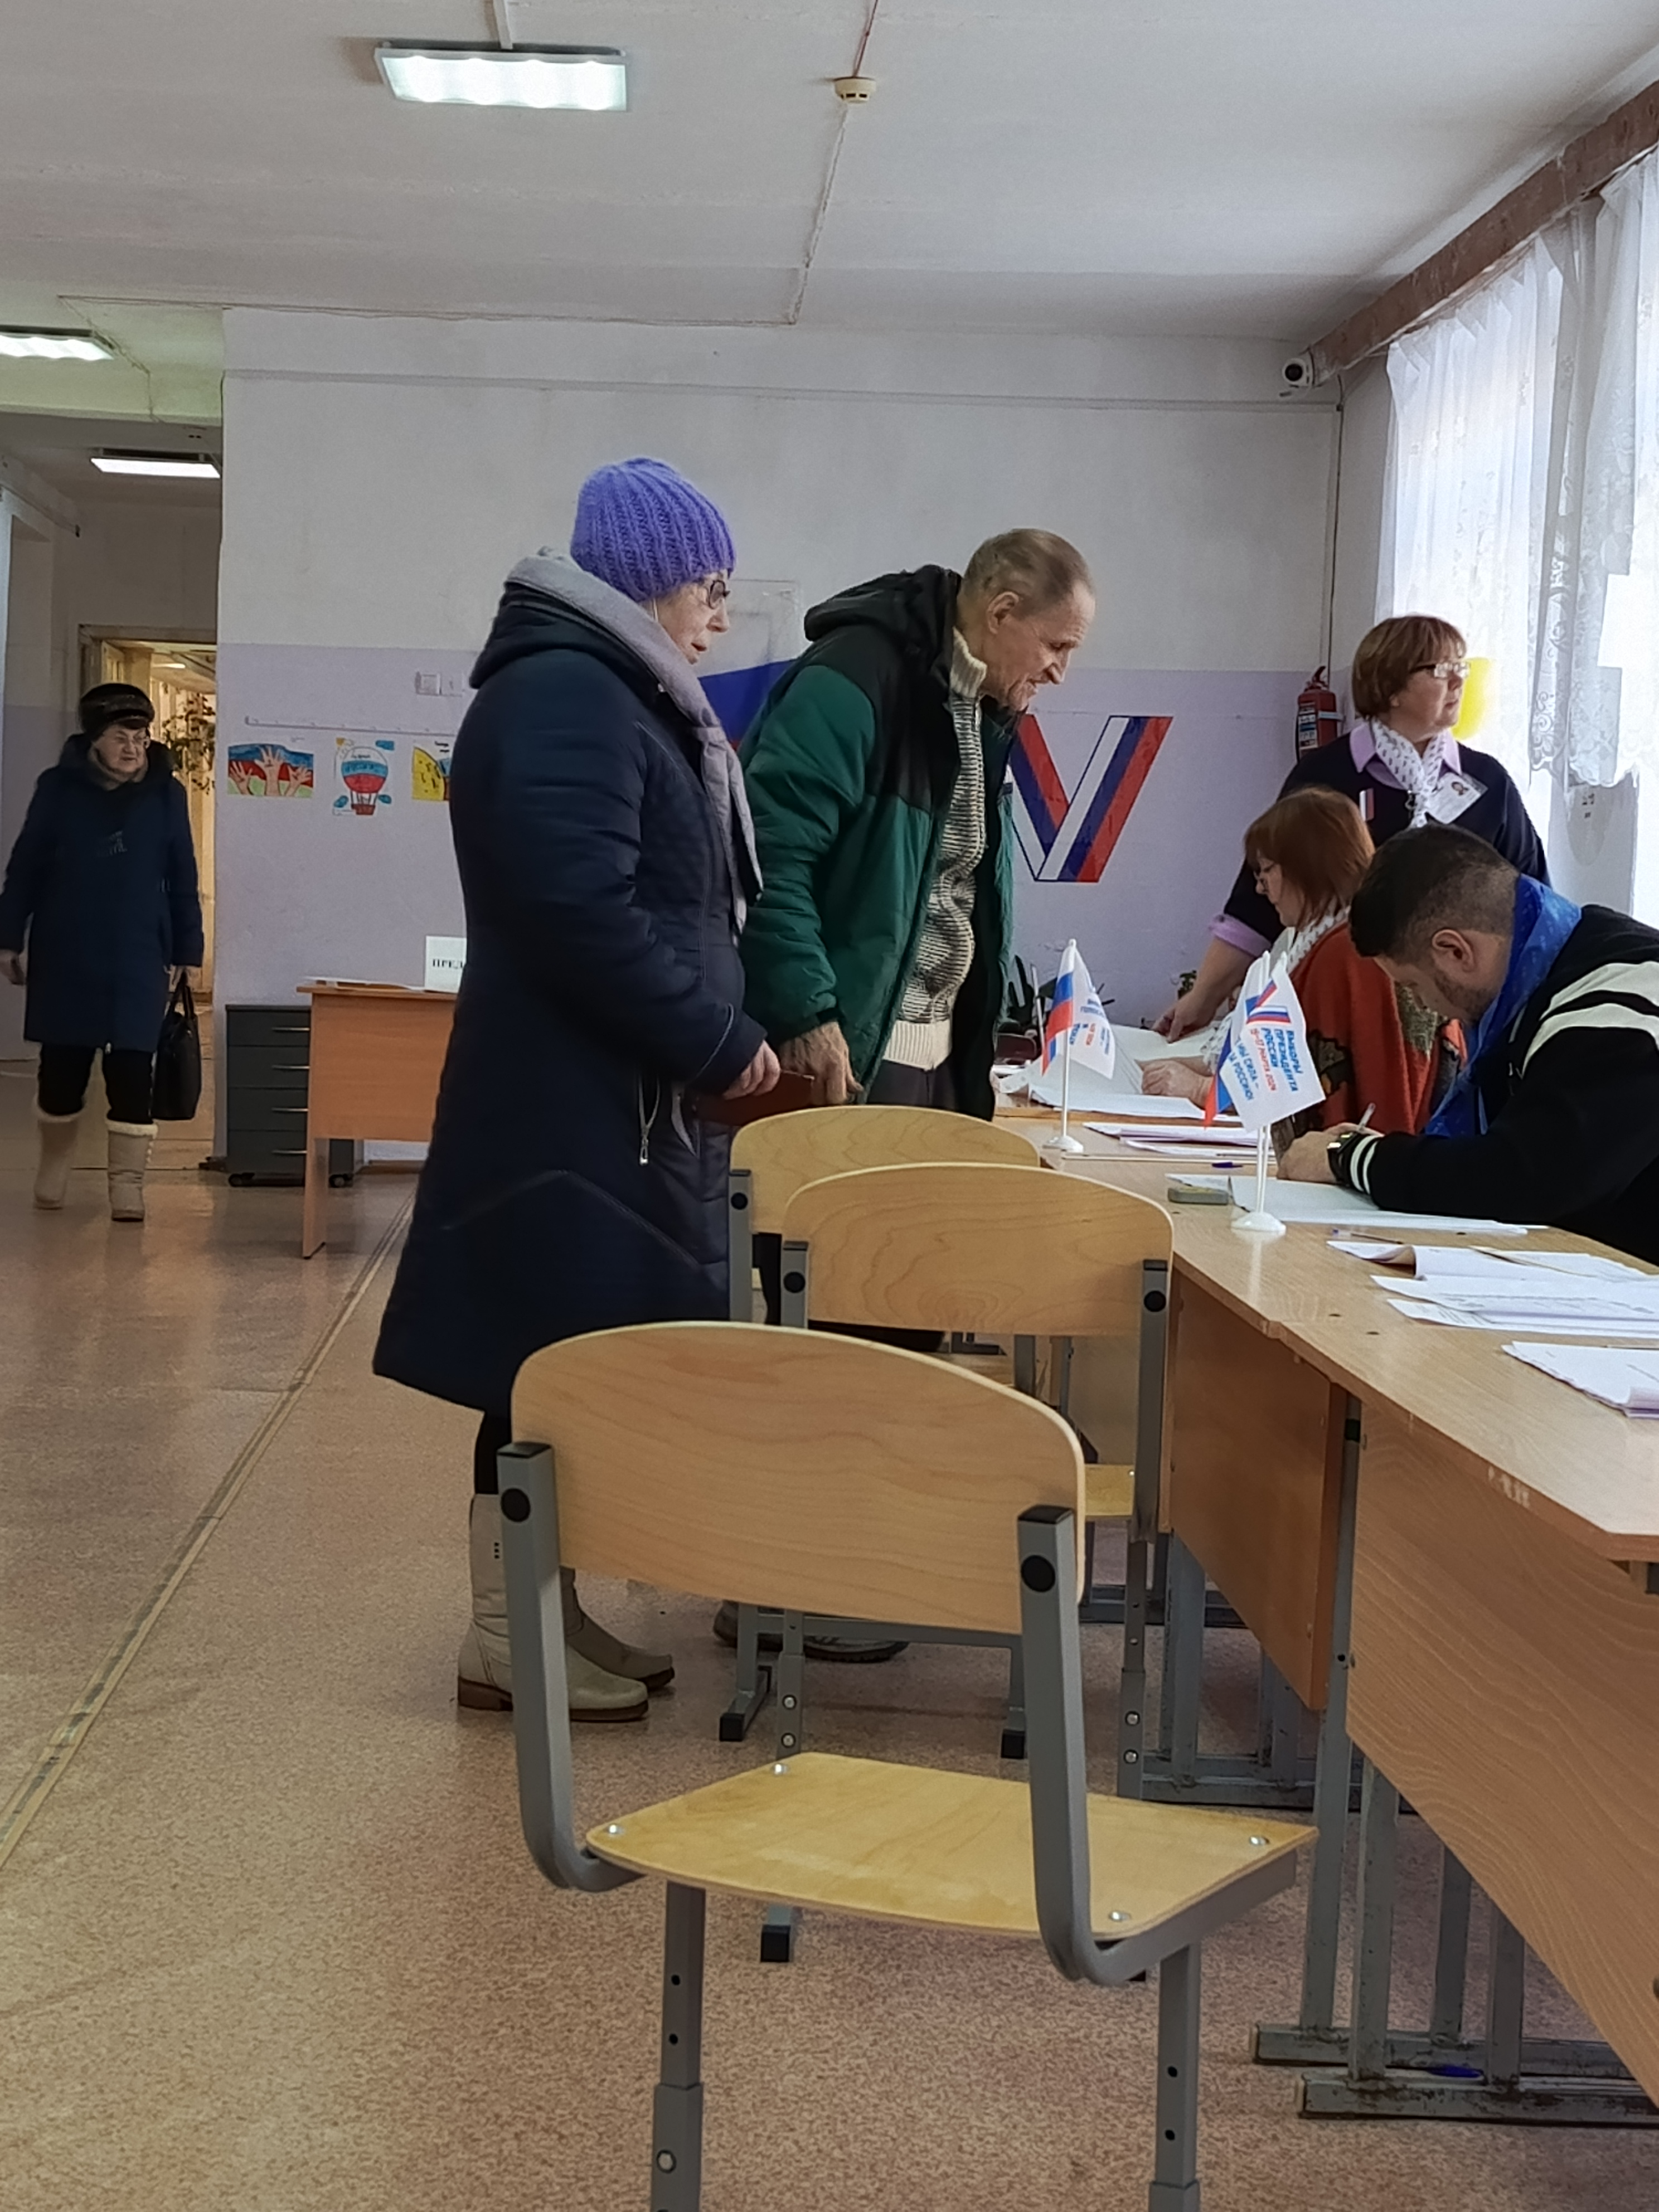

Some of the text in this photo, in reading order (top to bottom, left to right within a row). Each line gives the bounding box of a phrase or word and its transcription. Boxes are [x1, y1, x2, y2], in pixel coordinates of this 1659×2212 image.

[1260, 1027, 1278, 1068] РОССИИ
[1274, 1029, 1298, 1092] ПРЕЗИДЕНТА
[1286, 1030, 1303, 1074] ВЫБОРЫ
